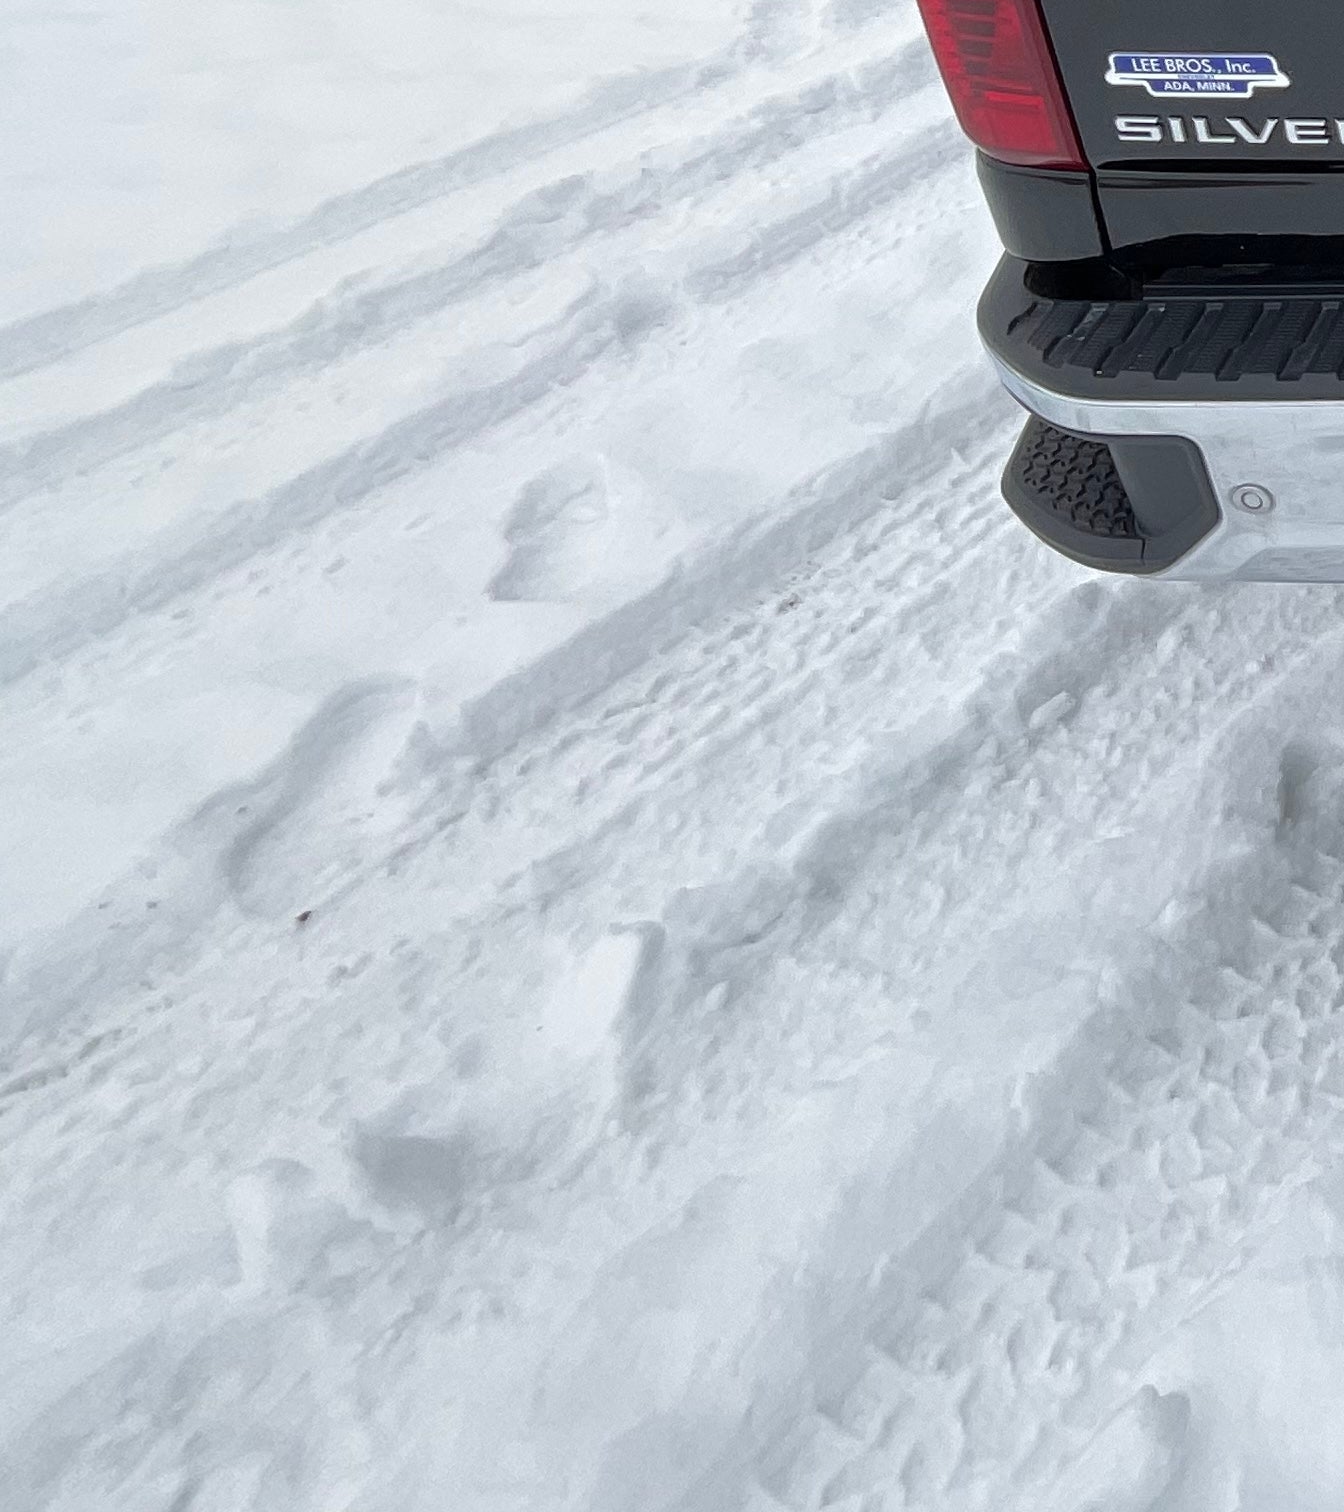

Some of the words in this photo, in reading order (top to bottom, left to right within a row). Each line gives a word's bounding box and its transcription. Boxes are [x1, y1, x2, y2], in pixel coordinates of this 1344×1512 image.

[1131, 58, 1161, 72] LEE
[1225, 59, 1256, 73] Inc.
[1197, 81, 1235, 92] MINN.
